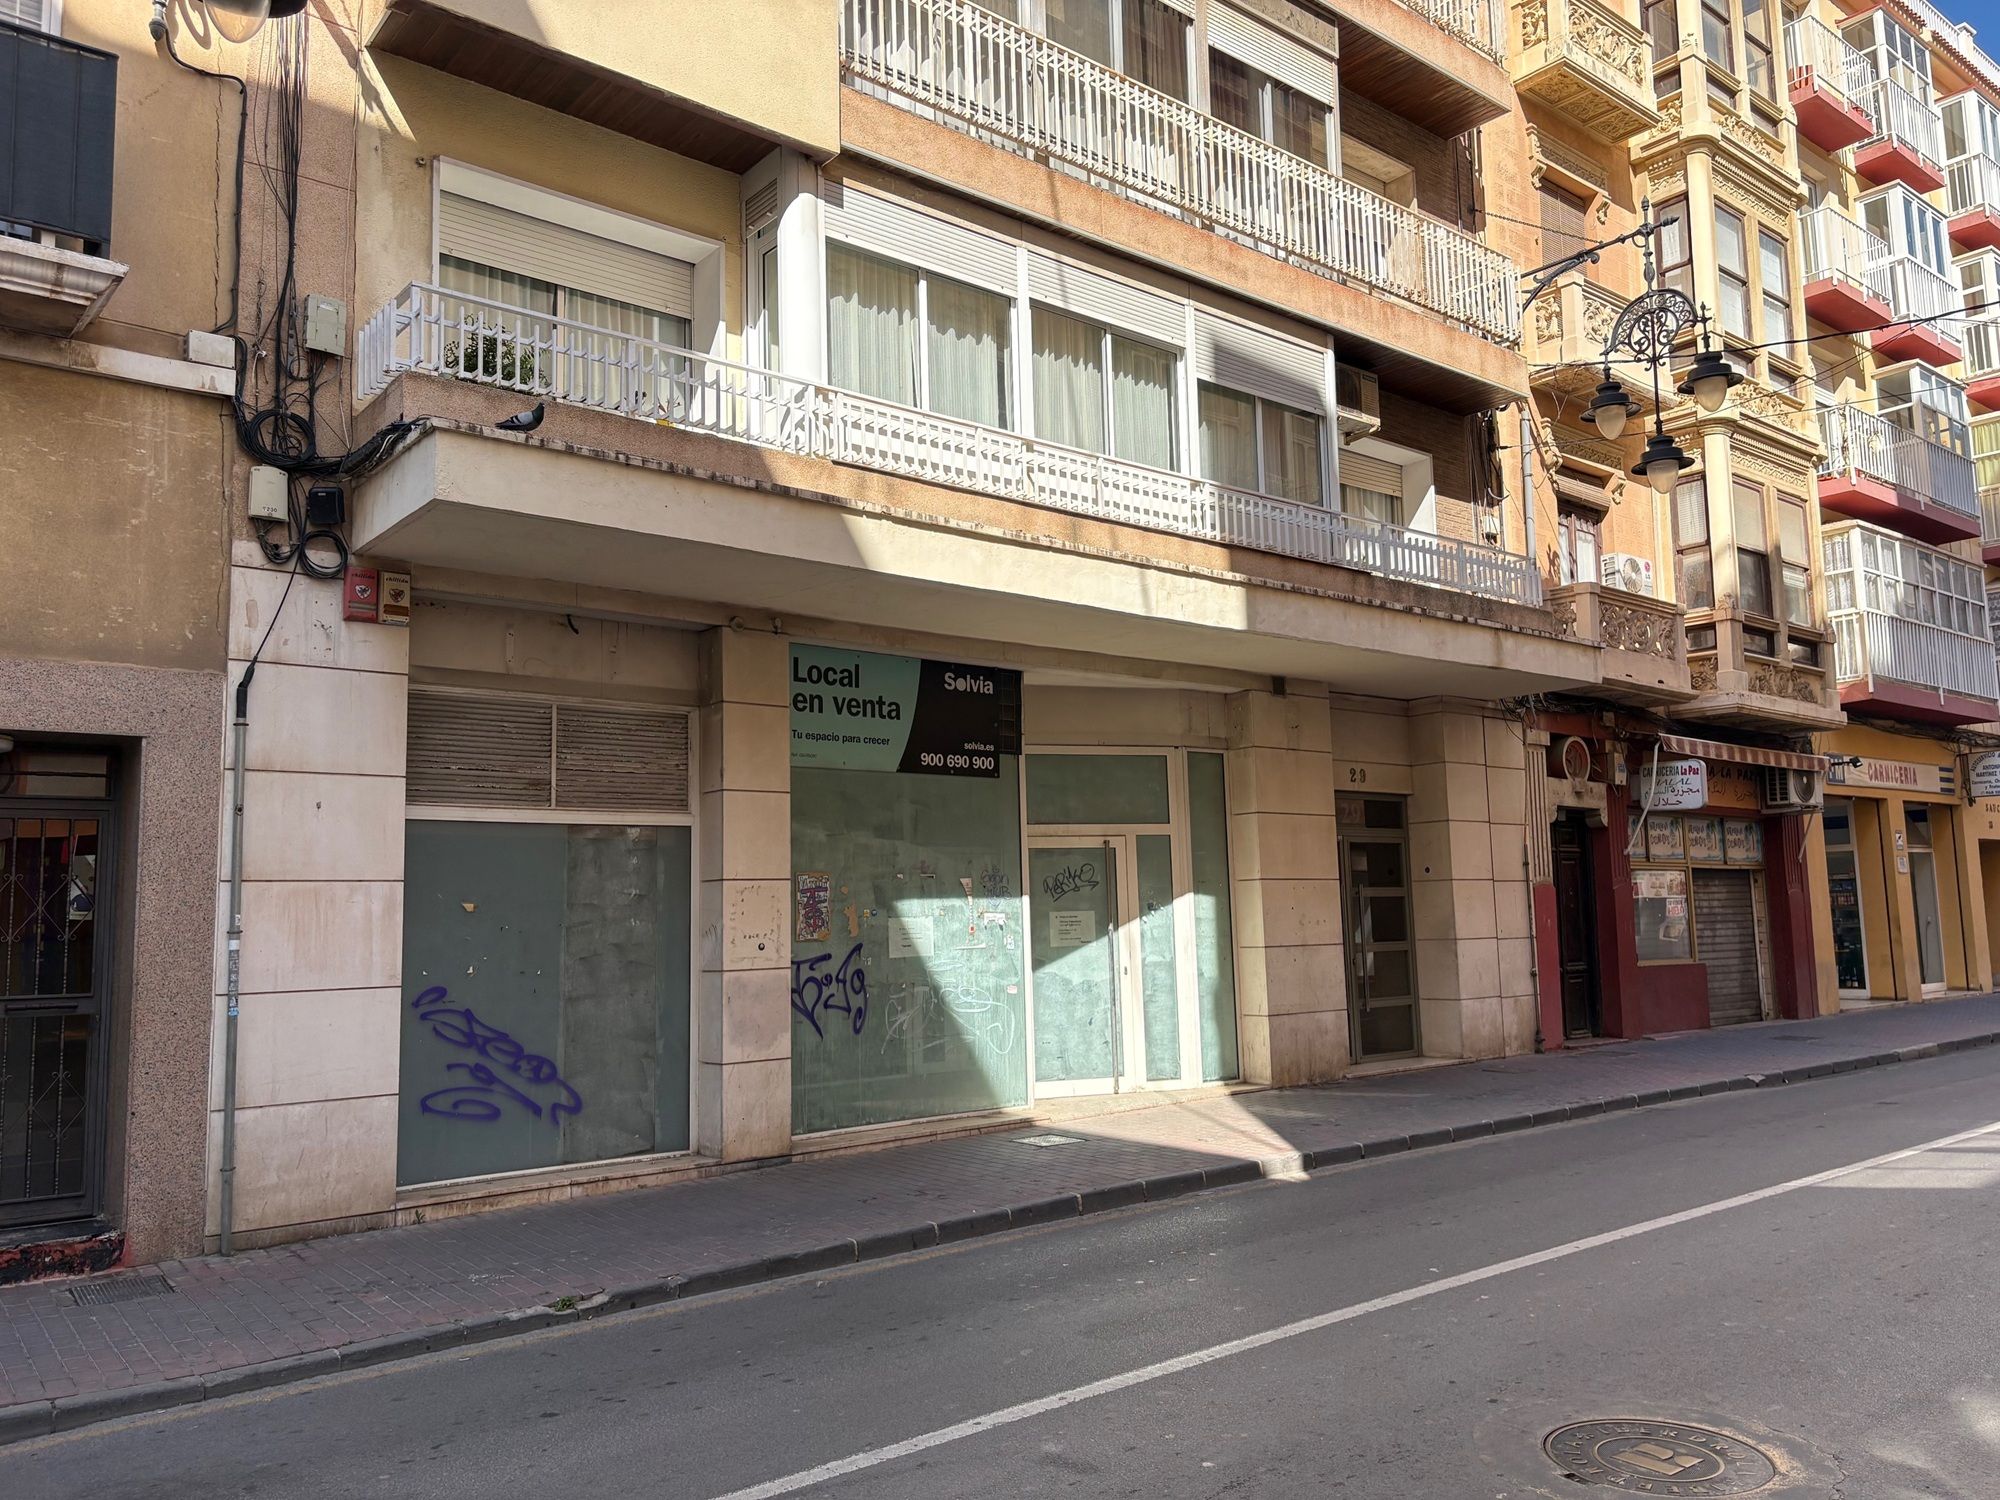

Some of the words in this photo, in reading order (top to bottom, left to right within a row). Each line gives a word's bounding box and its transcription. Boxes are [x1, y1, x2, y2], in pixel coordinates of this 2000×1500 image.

[793, 656, 860, 689] Local
[943, 672, 994, 695] Solvia
[792, 692, 823, 714] en
[832, 695, 901, 721] venta
[791, 729, 803, 740] Tu
[805, 731, 840, 743] espacio
[842, 735, 861, 745] para
[863, 736, 890, 746] crecer
[963, 741, 995, 751] solvia.es
[920, 752, 944, 766] 900
[946, 754, 970, 768] 690
[972, 755, 995, 770] 900
[1680, 764, 1687, 776] La
[1688, 764, 1700, 776] Paz
[1867, 762, 1918, 786] CARNICERIA
